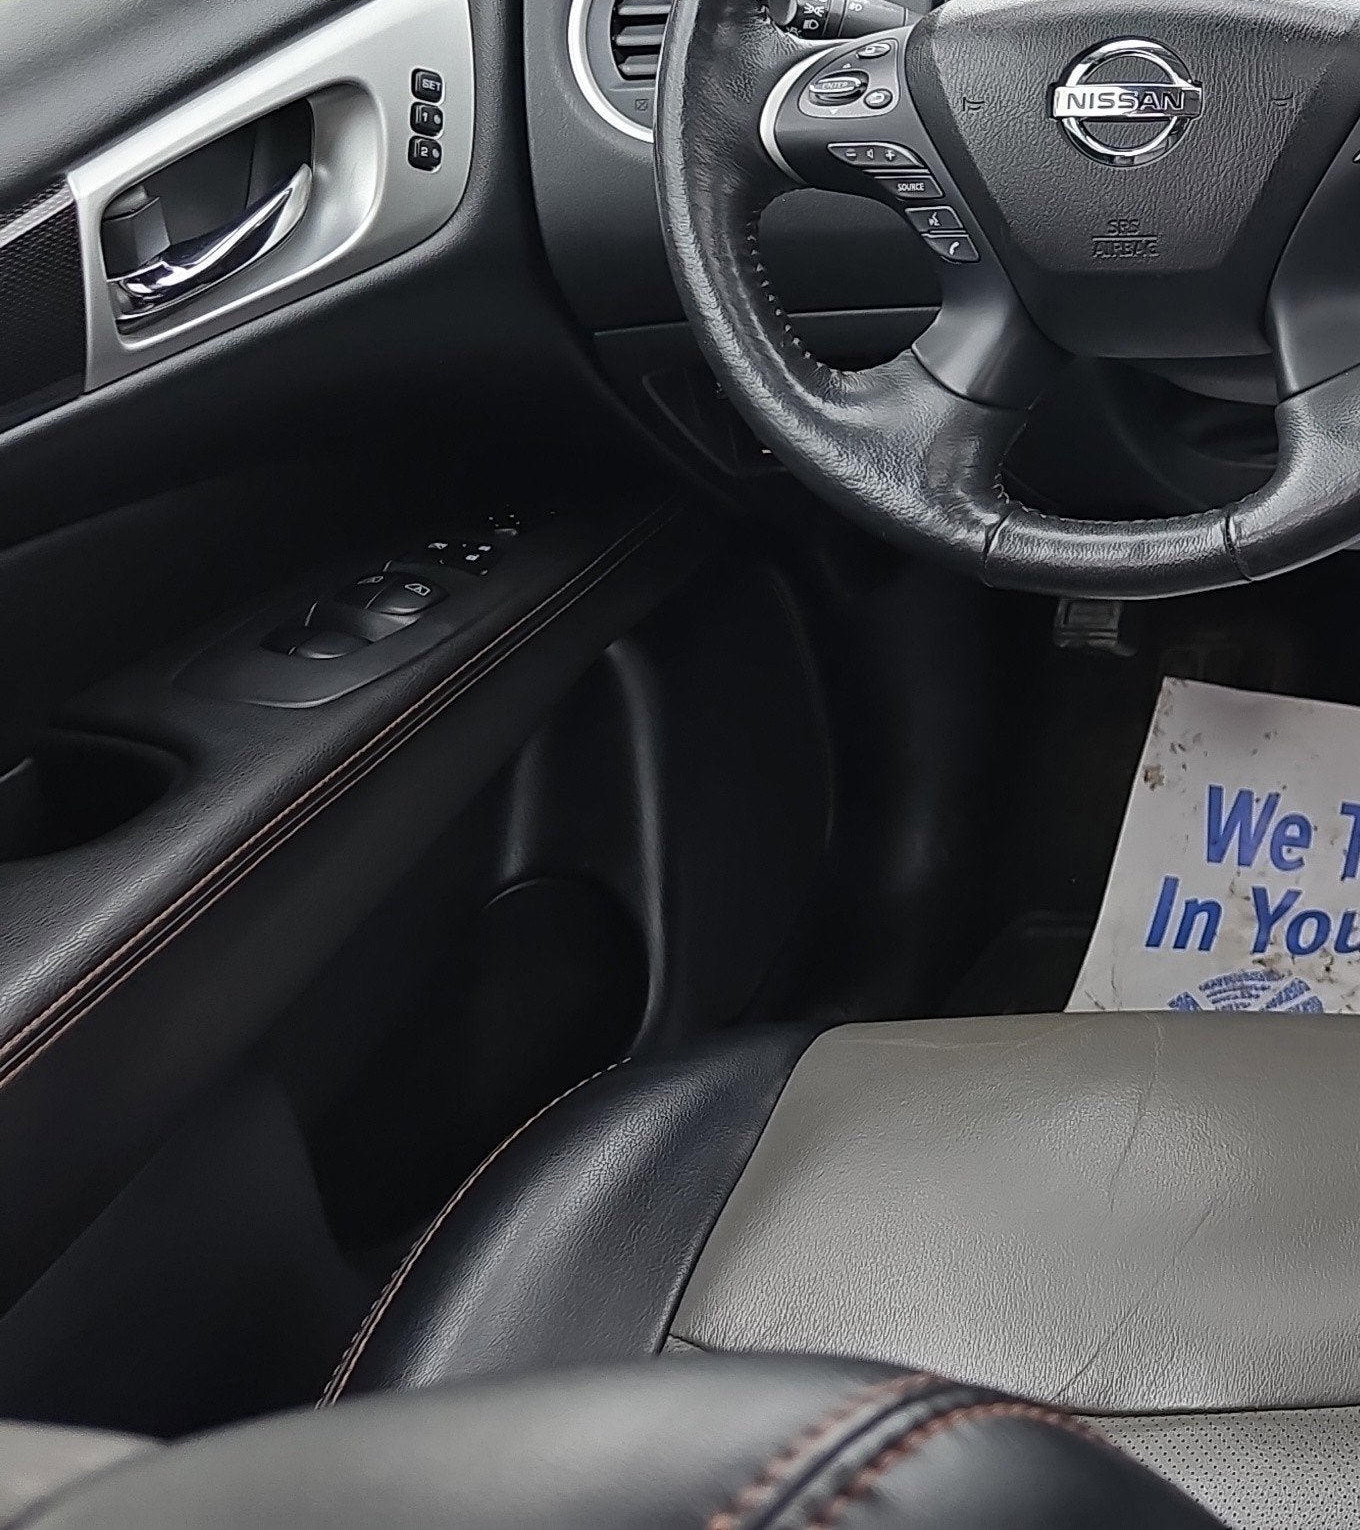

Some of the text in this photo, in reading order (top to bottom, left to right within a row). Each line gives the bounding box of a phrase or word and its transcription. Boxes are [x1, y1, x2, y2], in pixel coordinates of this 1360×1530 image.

[422, 79, 441, 91] SET
[1067, 90, 1185, 110] NISSAN
[422, 112, 428, 122] 1
[421, 147, 428, 157] 2
[897, 183, 924, 192] SOURCE
[1205, 784, 1311, 871] We
[1144, 875, 1221, 951] In
